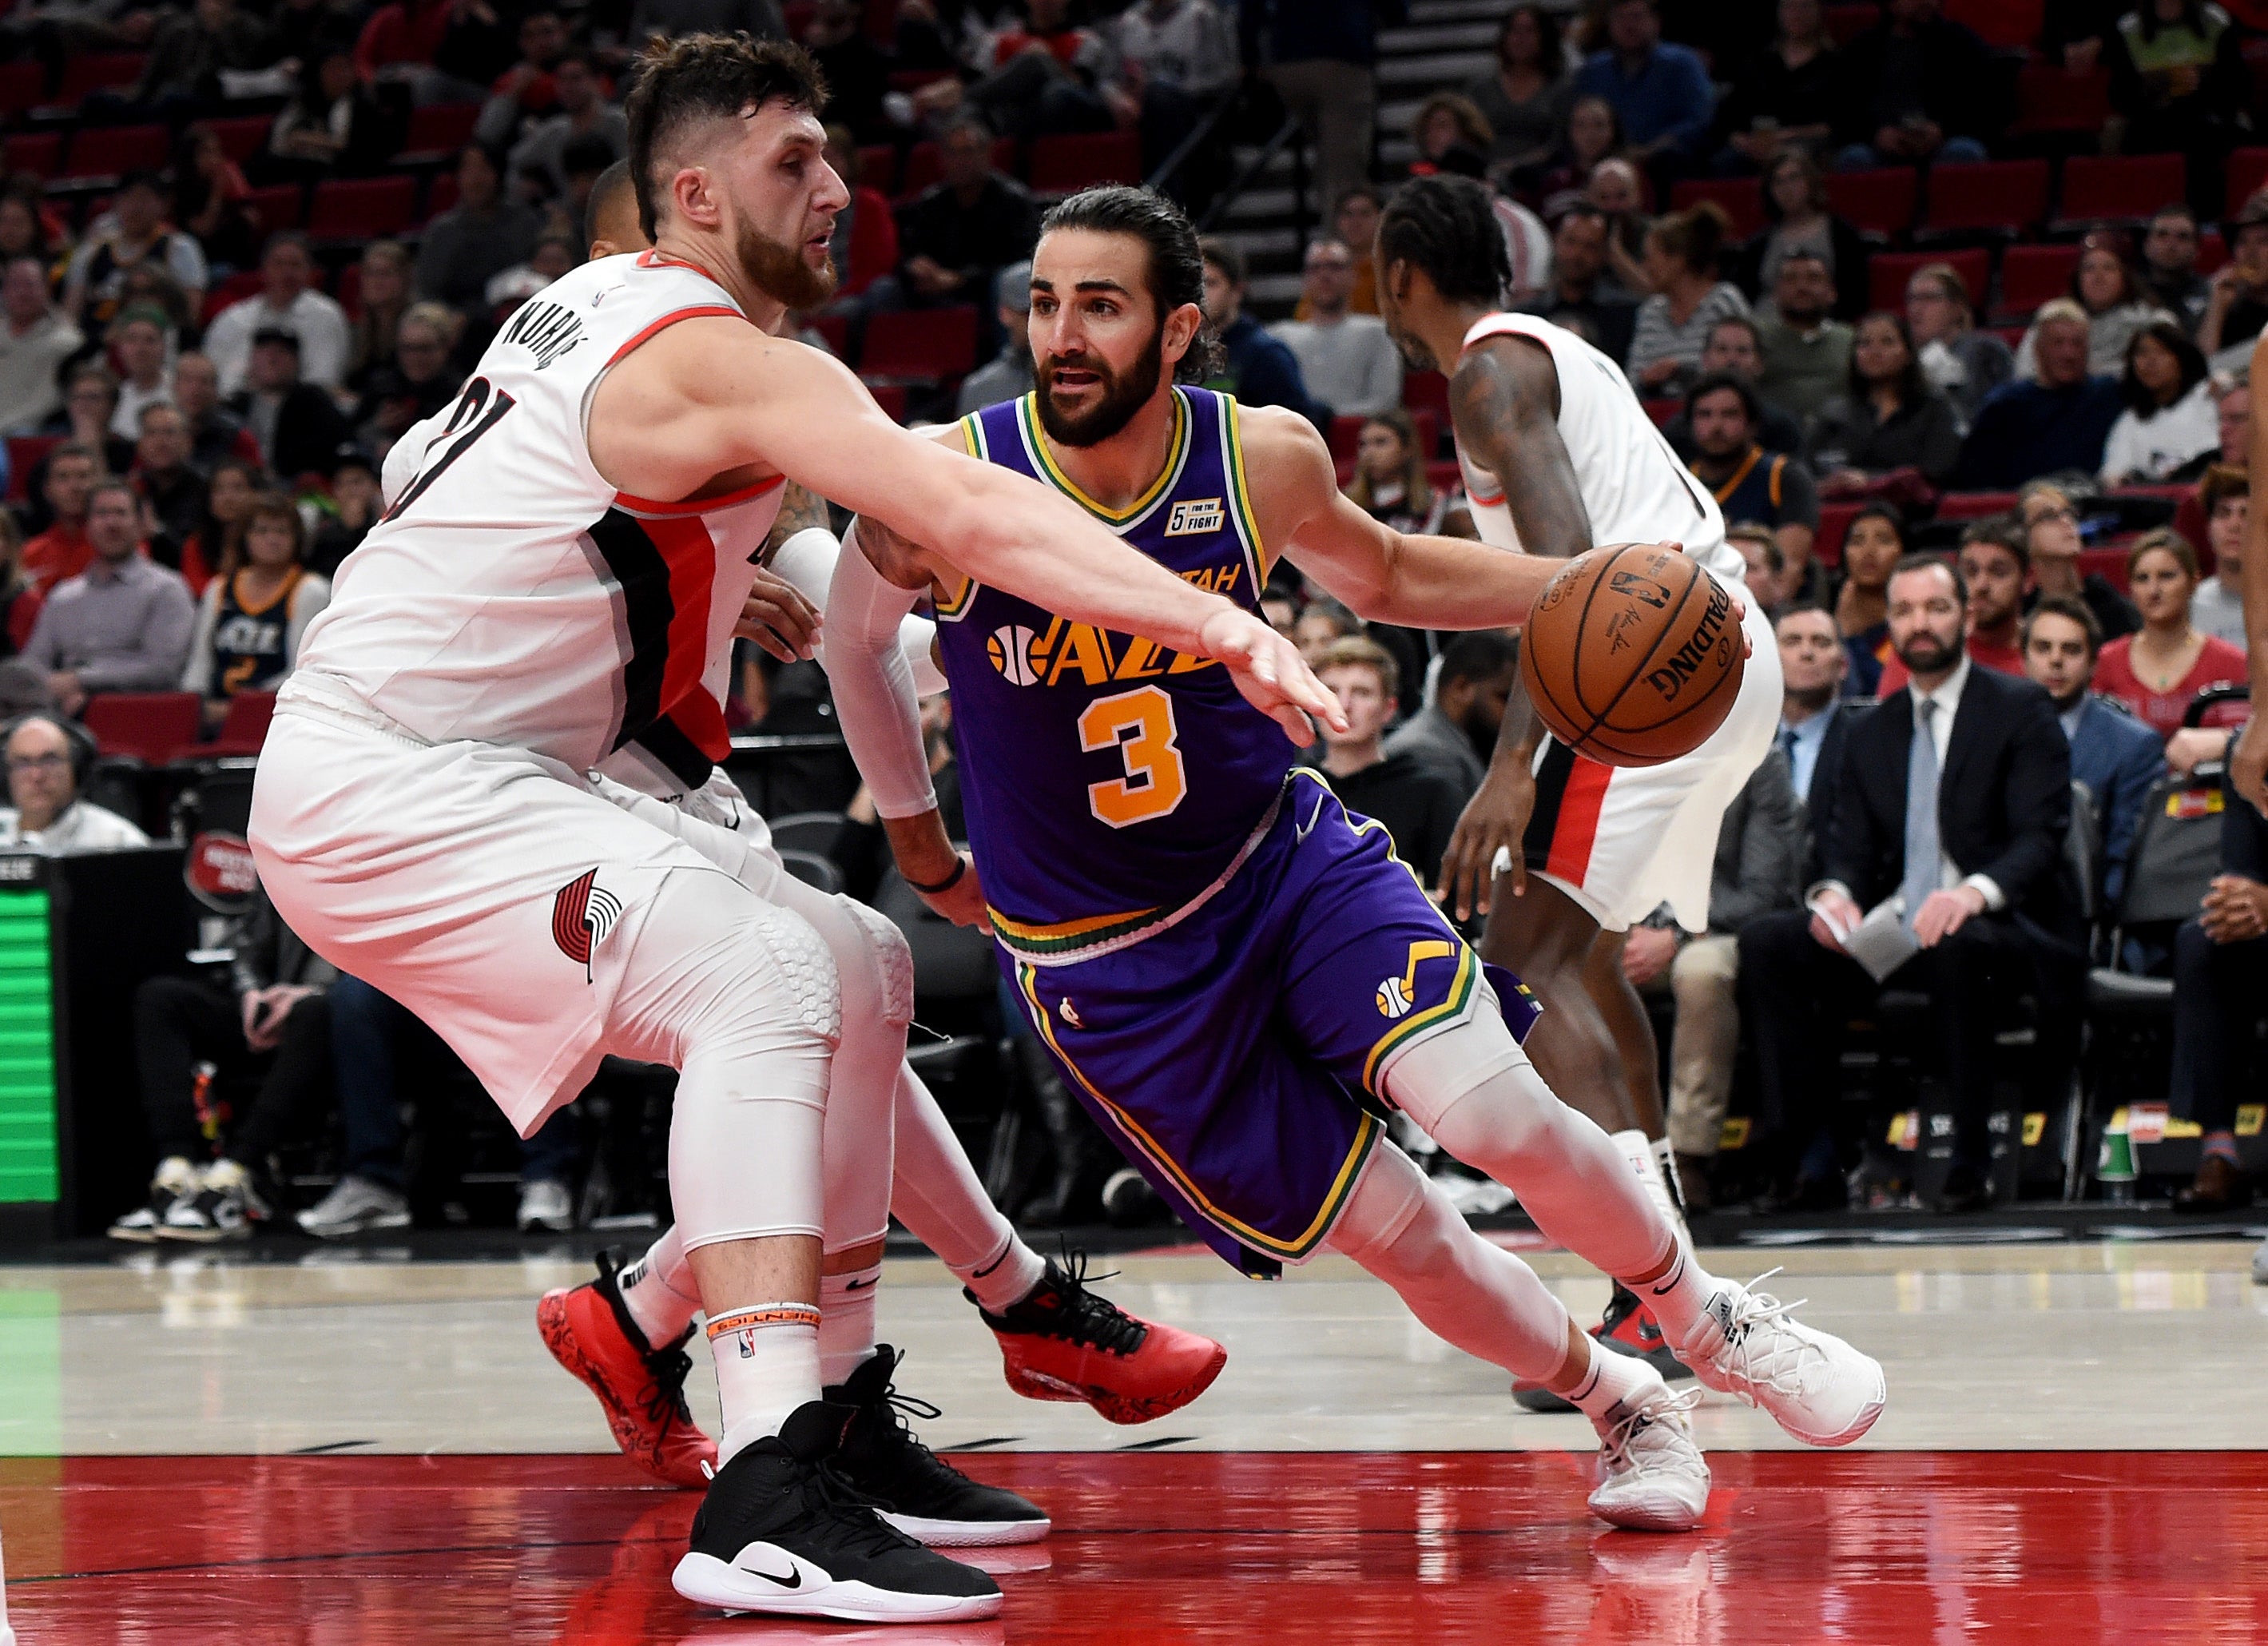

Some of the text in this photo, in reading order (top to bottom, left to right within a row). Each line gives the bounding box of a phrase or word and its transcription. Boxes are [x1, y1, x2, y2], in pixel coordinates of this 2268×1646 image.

[1171, 507, 1186, 531] 5
[1187, 515, 1219, 530] FIGHT
[1178, 563, 1241, 592] TAH
[1077, 684, 1187, 829] 3
